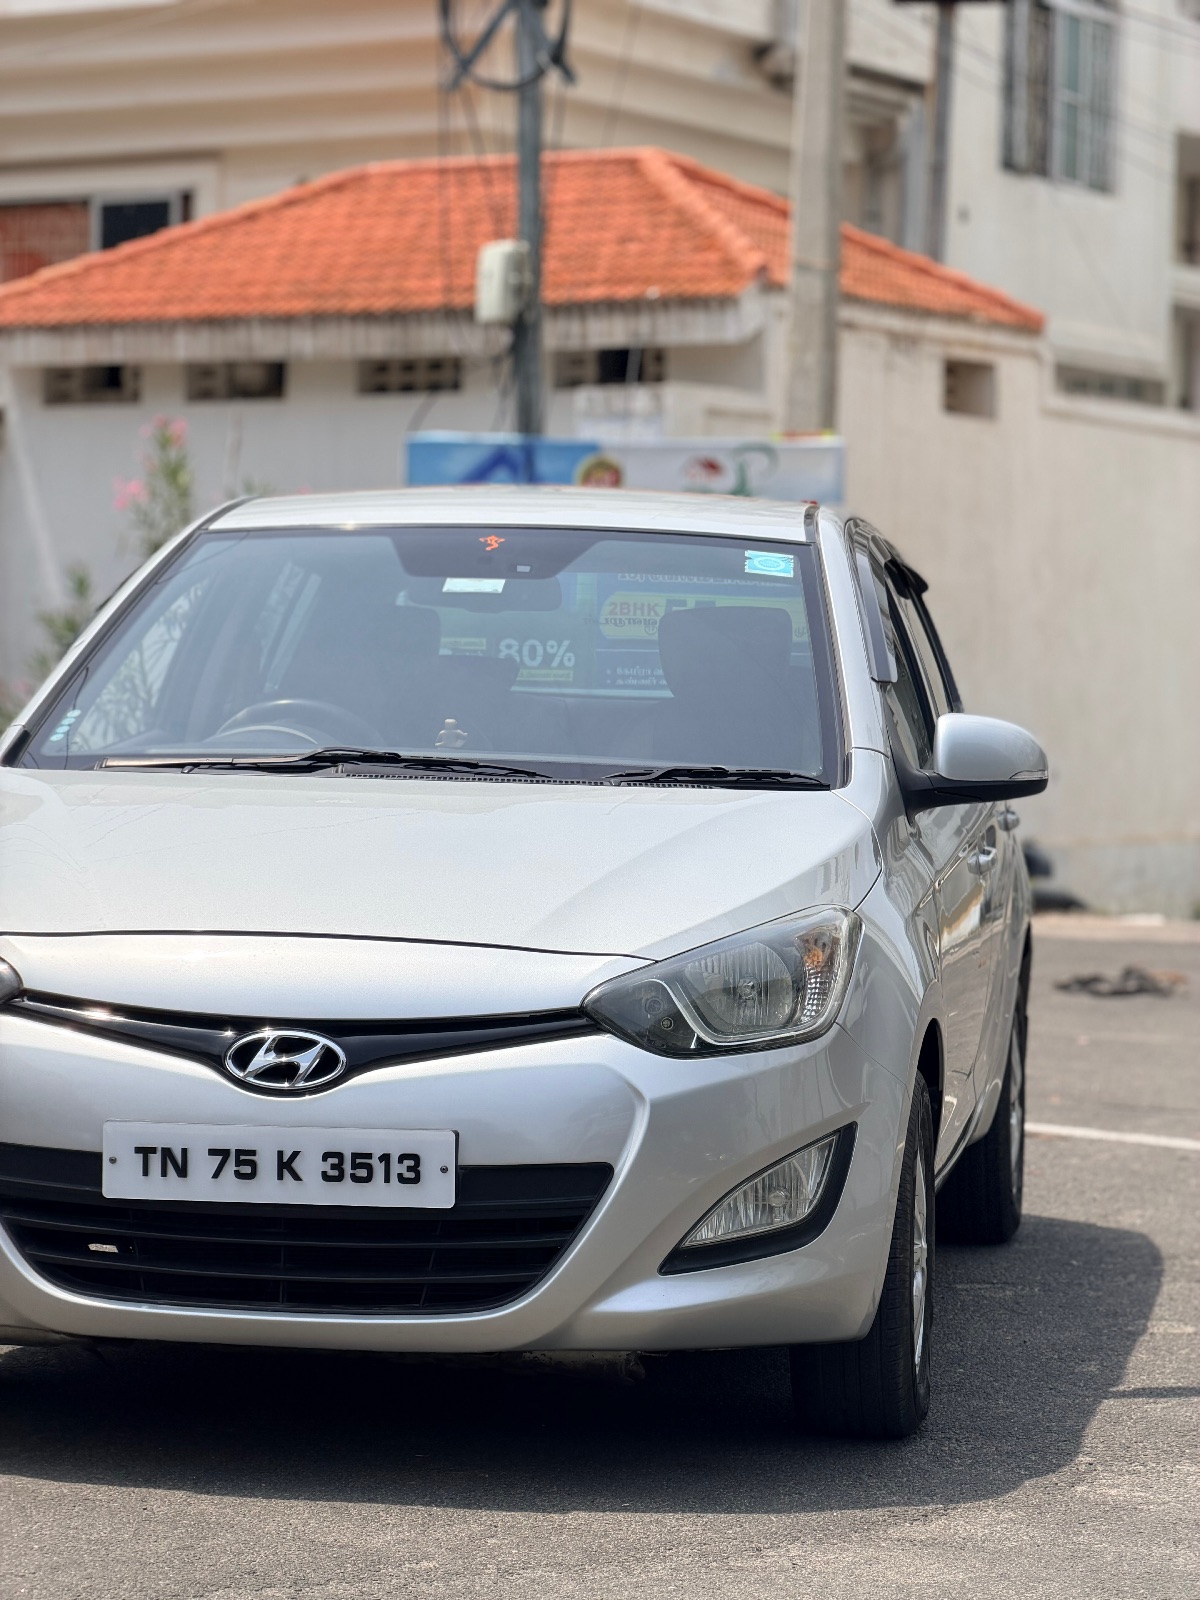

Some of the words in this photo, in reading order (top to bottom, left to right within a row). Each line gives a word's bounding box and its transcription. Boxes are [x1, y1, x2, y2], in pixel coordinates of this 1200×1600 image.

[608, 602, 661, 617] 2BHK
[498, 638, 576, 668] 80%
[134, 1146, 188, 1179] TN
[207, 1148, 257, 1181] 75
[276, 1150, 303, 1182] K
[321, 1151, 421, 1185] 3513
